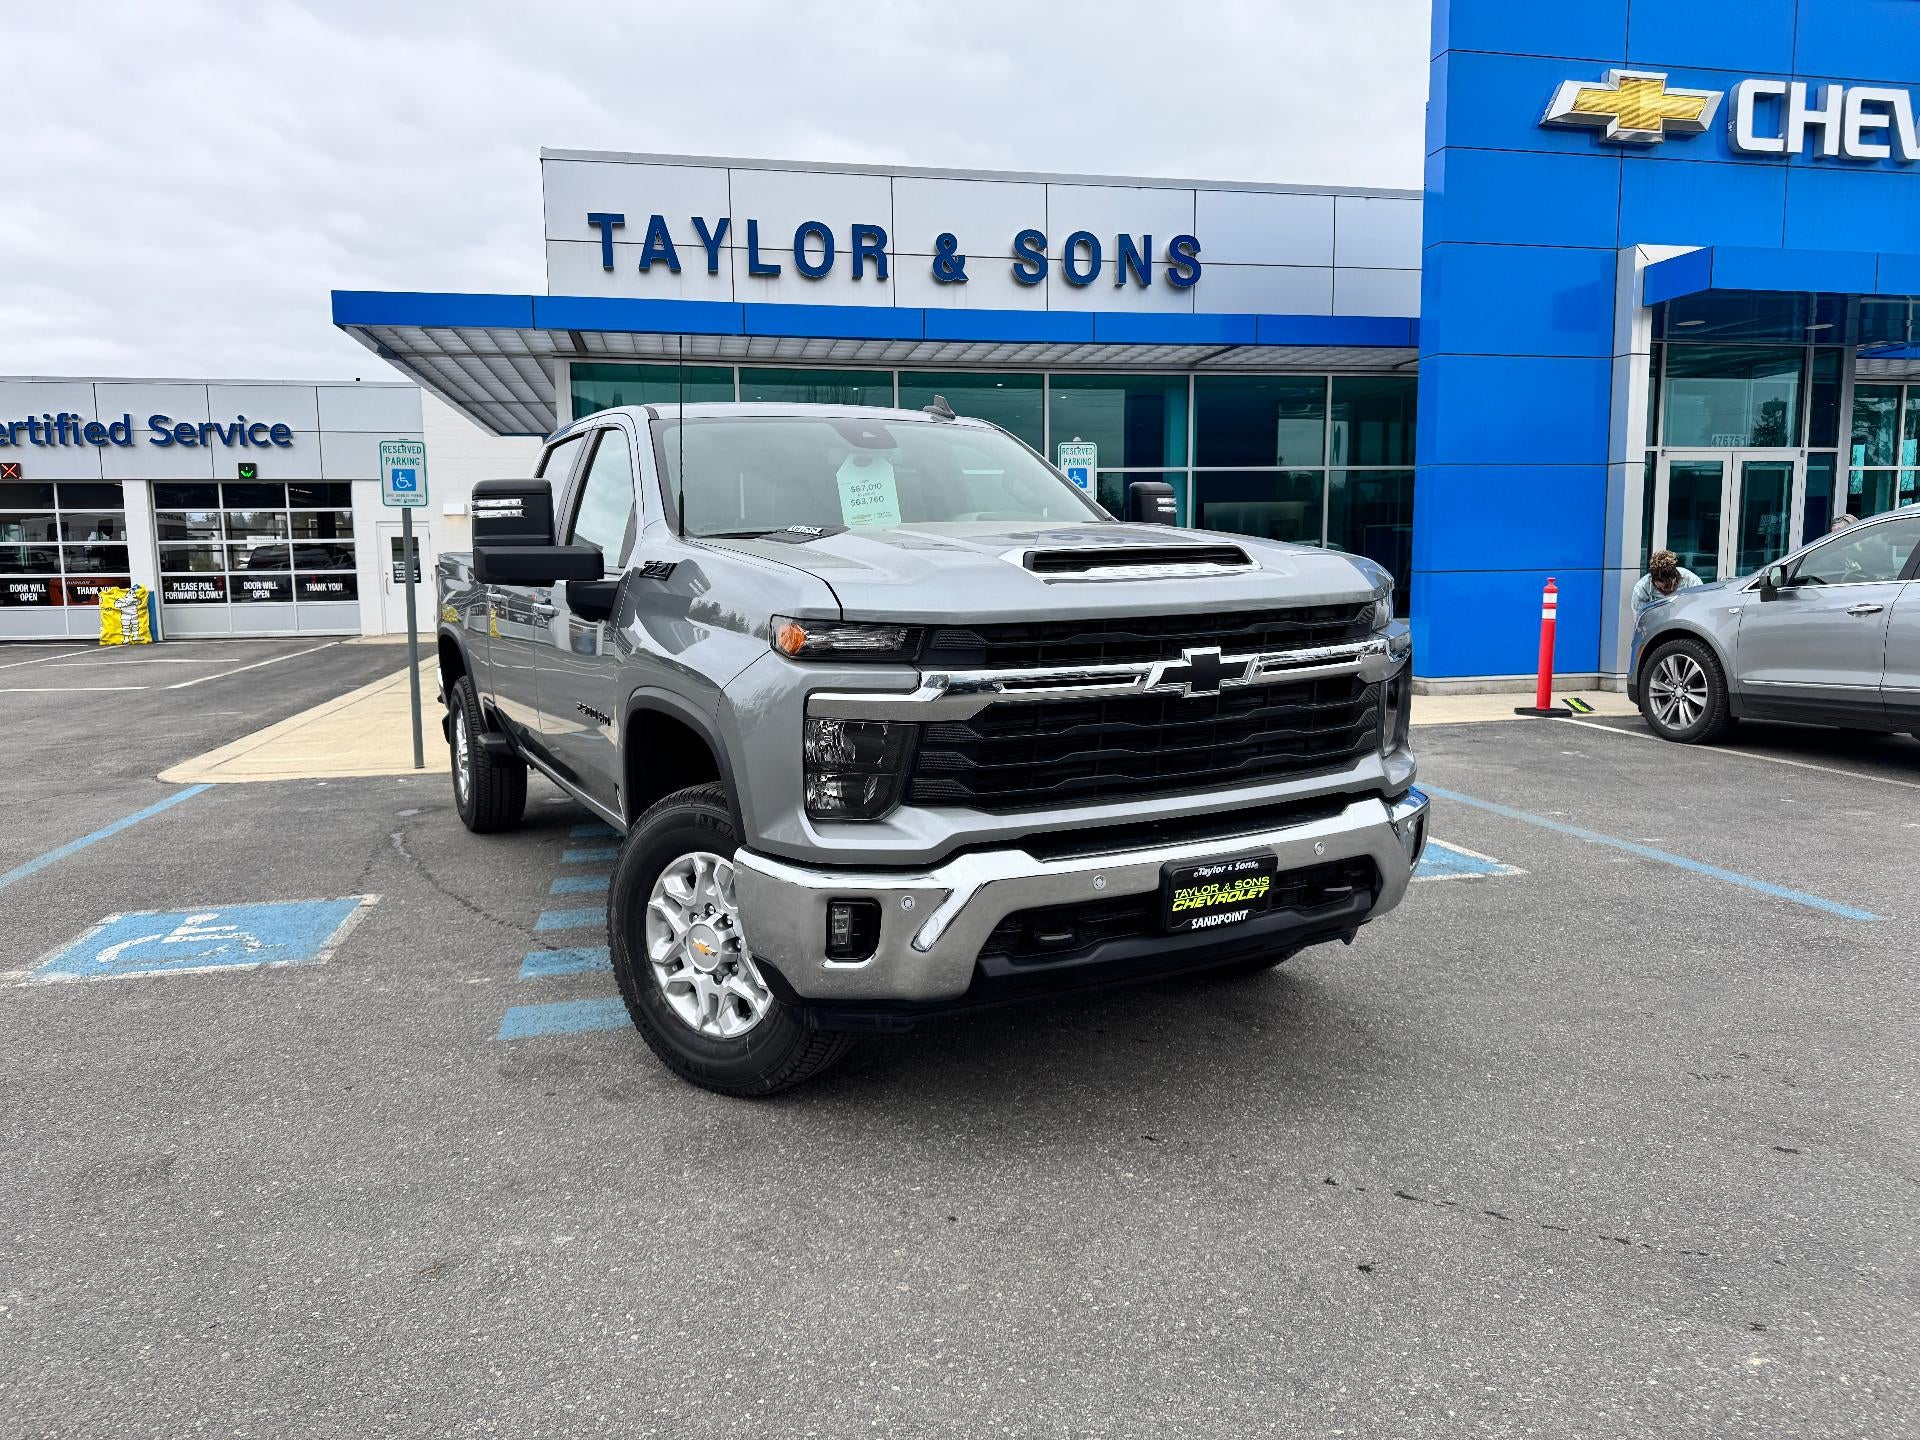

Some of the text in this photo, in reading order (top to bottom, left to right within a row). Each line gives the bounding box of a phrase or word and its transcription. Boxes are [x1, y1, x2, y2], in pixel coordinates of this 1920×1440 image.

[587, 212, 1202, 288] TAYLOR & SONS
[147, 414, 293, 447] Service
[382, 445, 422, 455] RESERVED
[1062, 447, 1093, 455] RESERVED
[385, 457, 420, 466] PARKING
[850, 482, 882, 493] $67,010
[10, 583, 47, 592] DOOR WILL
[76, 586, 99, 595] THANK
[173, 582, 215, 591] PLEASE PULL
[243, 581, 278, 590] DOOR WILL
[306, 582, 343, 592] THANK YOU!
[20, 592, 38, 602] OPEN
[165, 591, 224, 600] FORWARD SLOWLY
[252, 590, 270, 599] OPEN
[1197, 864, 1227, 878] Taylor
[1234, 861, 1256, 871] Sons
[1174, 876, 1270, 899] TAYLOR & SONS
[1172, 886, 1270, 912] CHEVROLET
[1191, 910, 1249, 929] SANDPOINT
